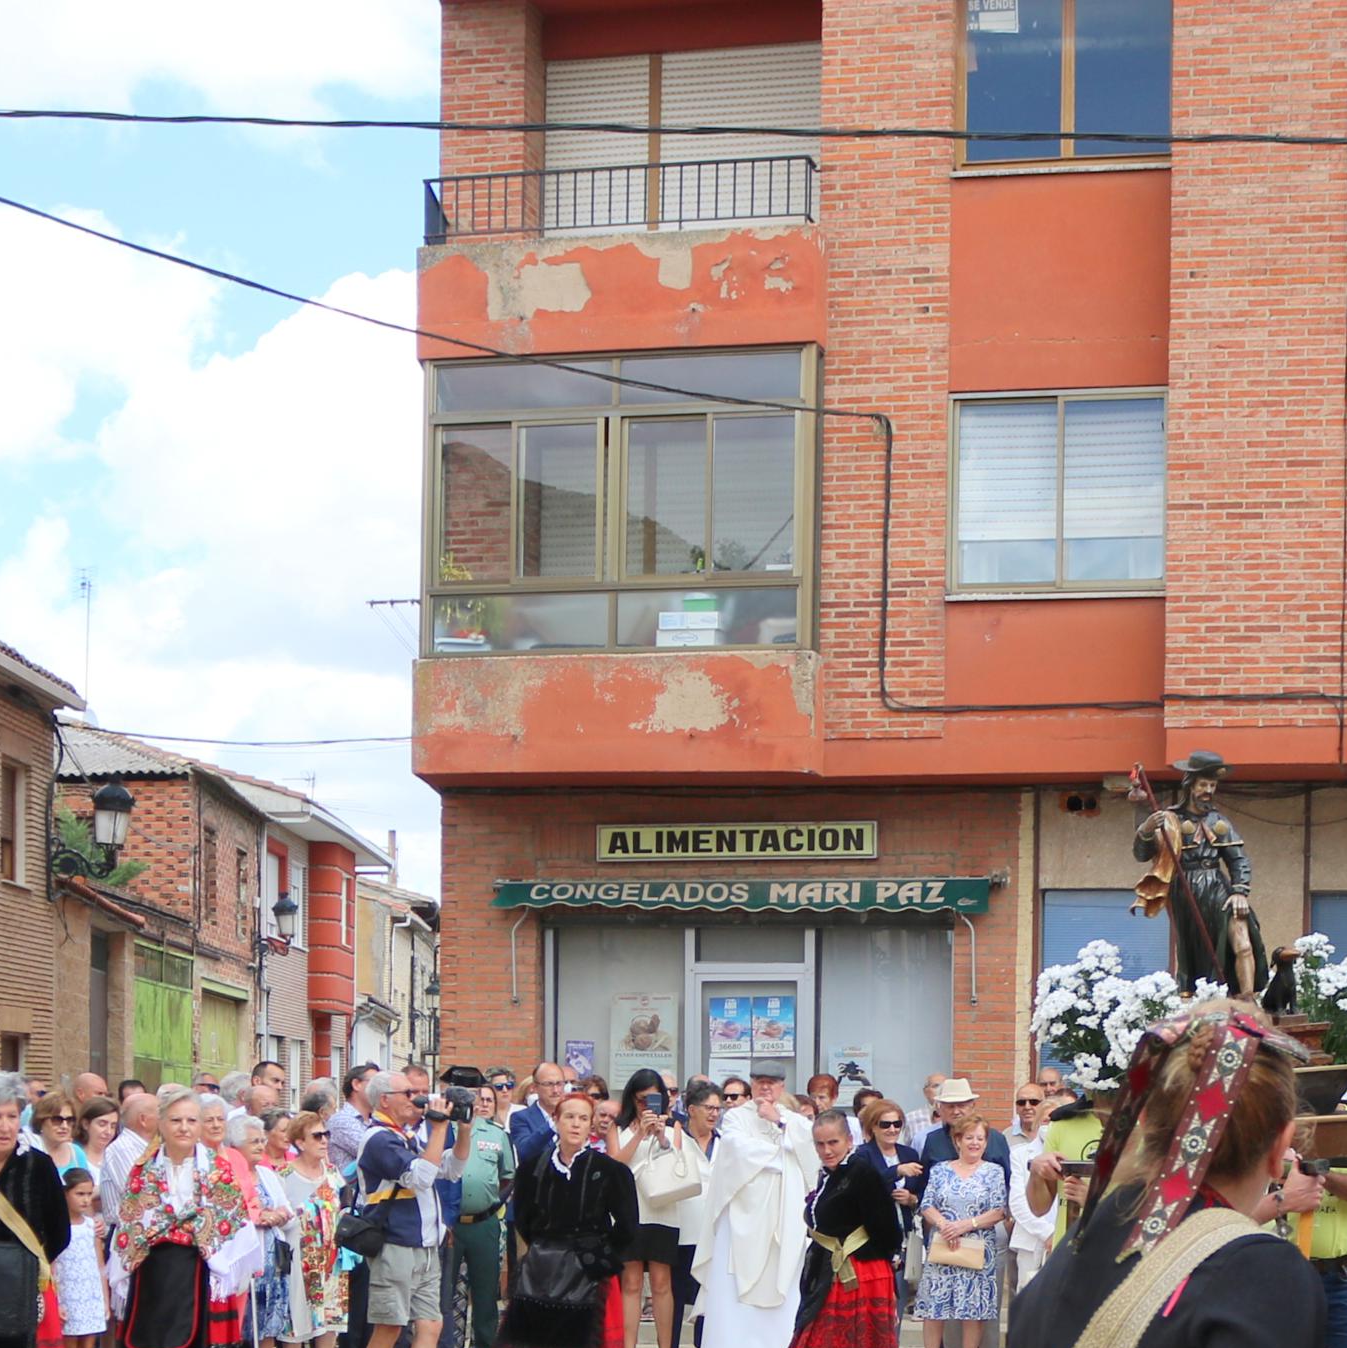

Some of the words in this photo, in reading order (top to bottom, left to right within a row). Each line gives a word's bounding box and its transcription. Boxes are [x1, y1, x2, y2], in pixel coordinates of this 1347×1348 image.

[982, 0, 1015, 10] VENDE
[607, 828, 865, 854] ALIMENTACION
[530, 882, 750, 902] CONGELADOS
[769, 882, 861, 904] MARI
[875, 881, 948, 904] PAZ
